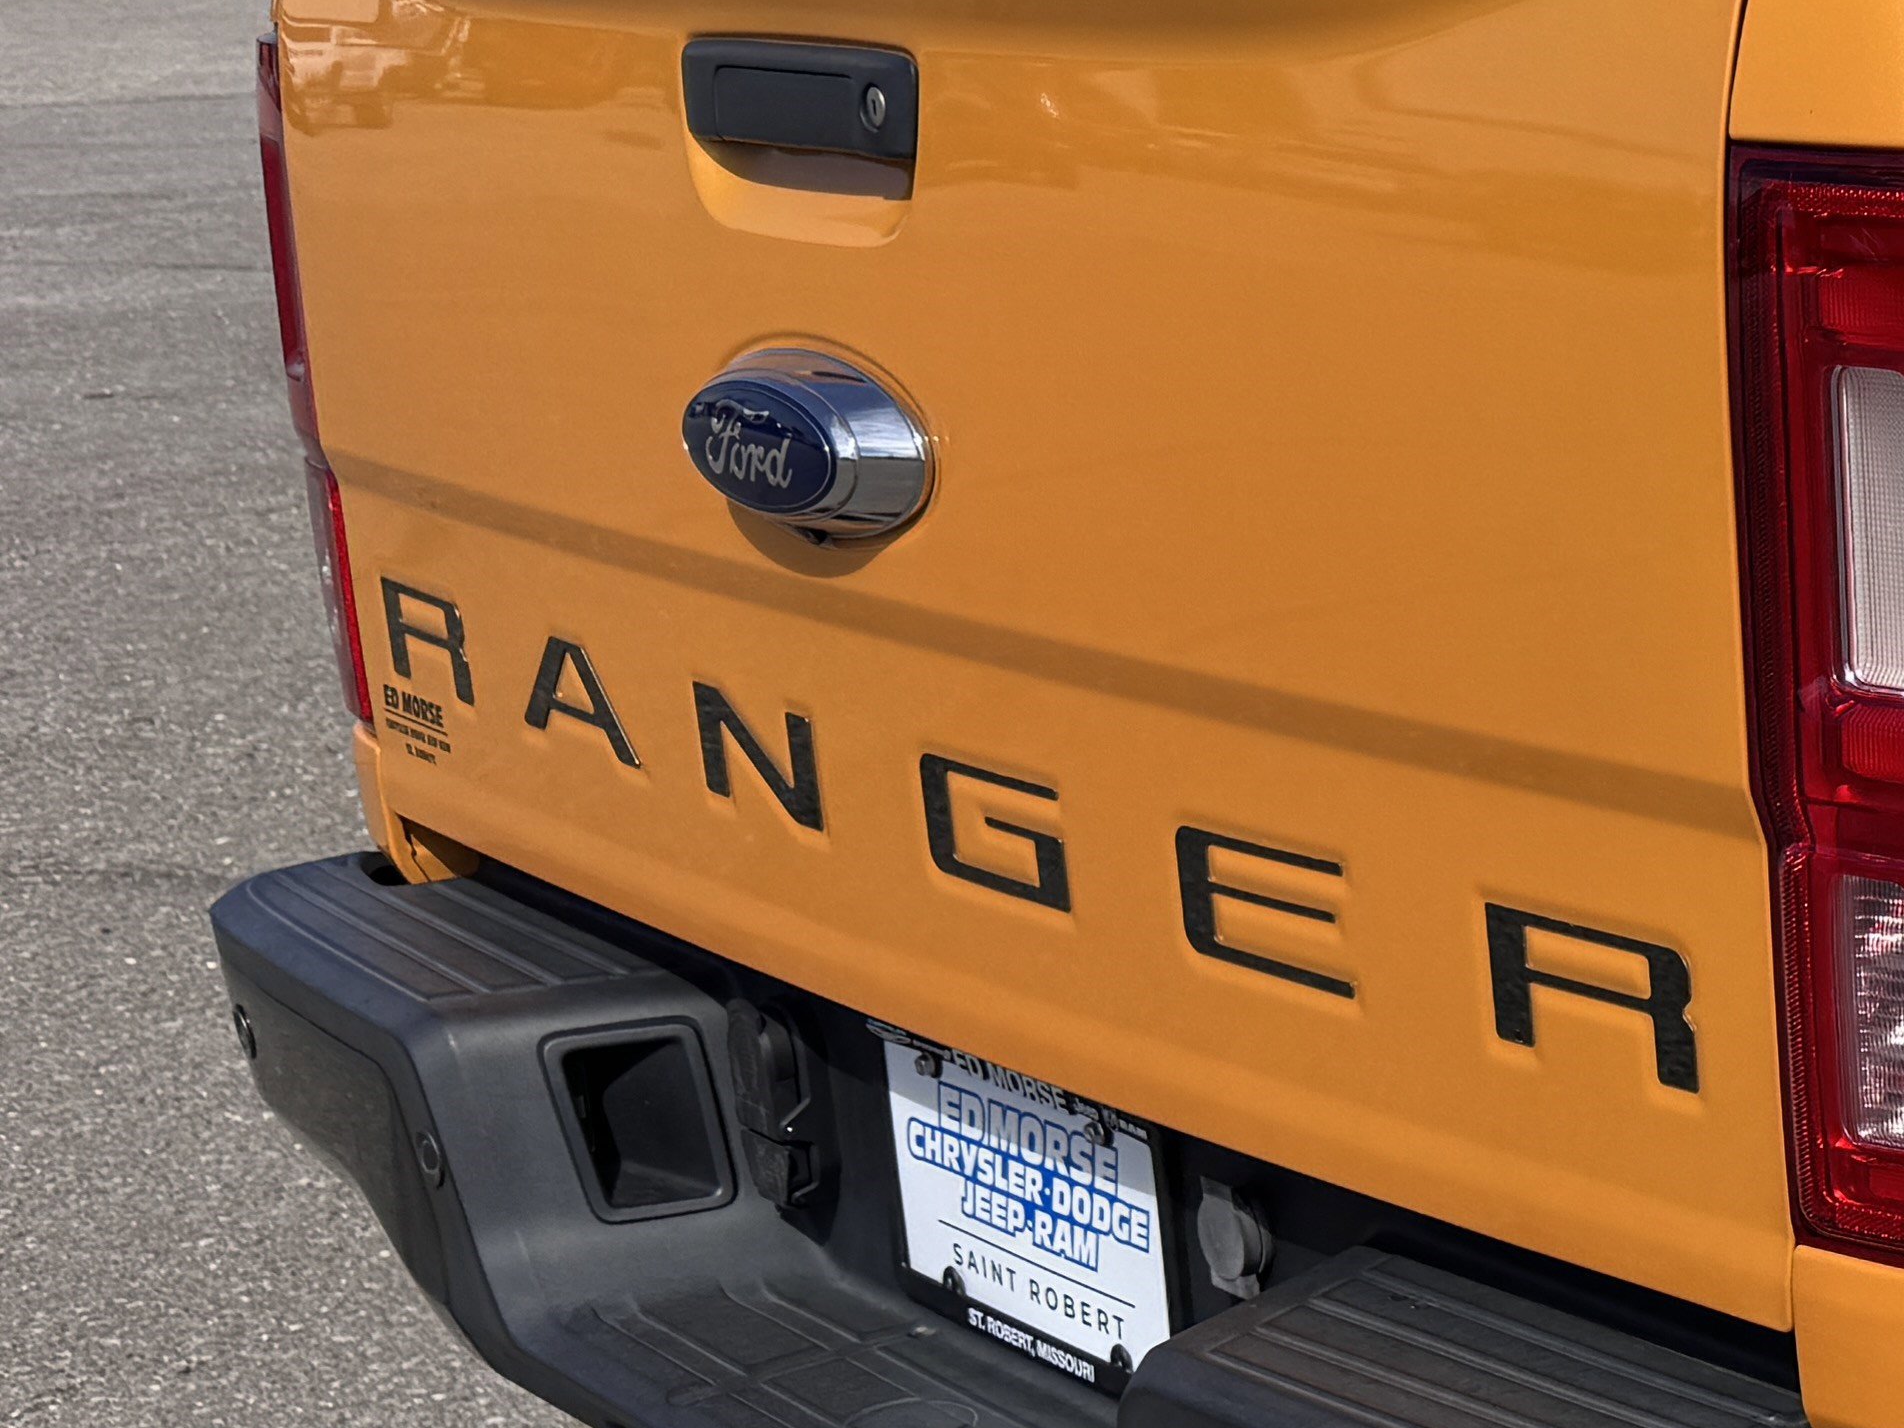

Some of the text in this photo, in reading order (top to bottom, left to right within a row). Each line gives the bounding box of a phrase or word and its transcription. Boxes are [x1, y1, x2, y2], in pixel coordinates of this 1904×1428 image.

[705, 398, 793, 489] Ford
[383, 684, 444, 729] ED MORSE
[380, 575, 1701, 1096] RANGER
[987, 1062, 1068, 1114] MORSE
[938, 1081, 1118, 1198] ED MORSE
[952, 1242, 1125, 1340] SAINT ROBERT
[1036, 1339, 1096, 1383] MISSOURI
